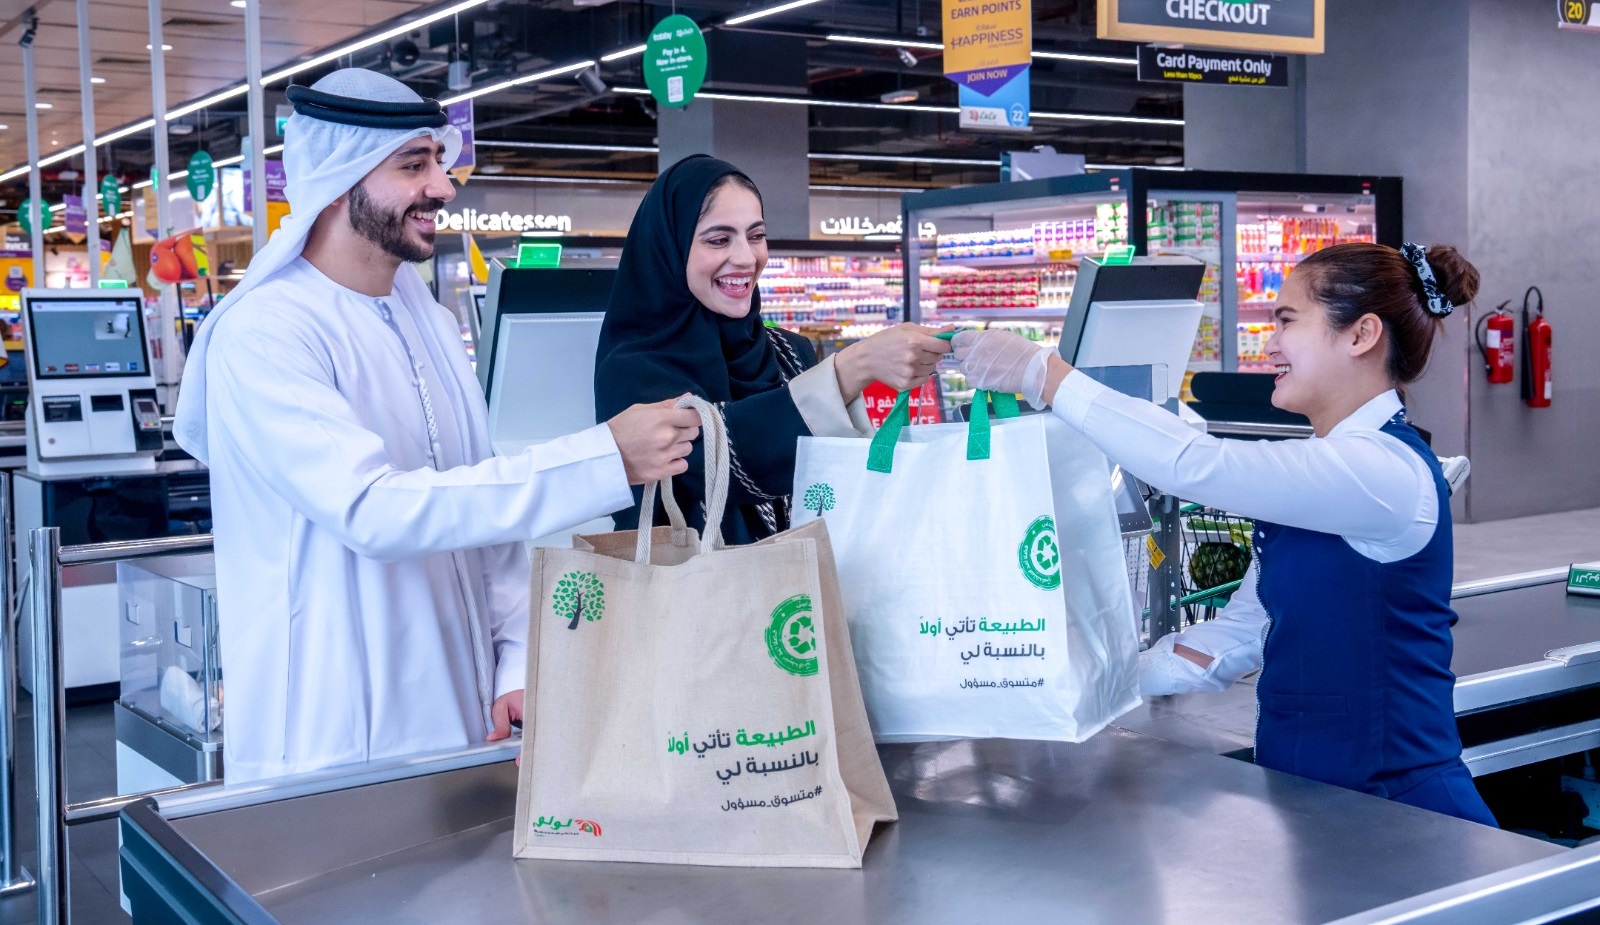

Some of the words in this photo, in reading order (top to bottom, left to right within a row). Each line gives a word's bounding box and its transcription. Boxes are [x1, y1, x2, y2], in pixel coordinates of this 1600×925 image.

[951, 6, 979, 19] EARN
[981, 0, 1022, 15] POINTS
[1165, 0, 1271, 26] CHECKOUT
[1567, 1, 1583, 19] 20
[951, 28, 1023, 50] HAPPINESS
[967, 73, 985, 83] JOIN
[986, 69, 1008, 80] NOW
[1156, 53, 1186, 69] Card
[1188, 54, 1241, 73] Payment
[1243, 59, 1272, 77] Only
[1012, 110, 1024, 122] 22
[436, 208, 572, 232] Delicatessen
[945, 616, 976, 641] تأتي
[979, 617, 1046, 635] الطبيعة
[960, 644, 980, 665] لي
[983, 642, 1045, 661] بالنسبة
[959, 678, 1044, 689] #متسوق_مسؤول
[692, 729, 731, 759] تأتي
[735, 719, 816, 748] الطبيعة
[715, 761, 742, 786] لي
[746, 750, 819, 777] بالنسبة
[721, 785, 823, 812] #متسوق_مسؤول
